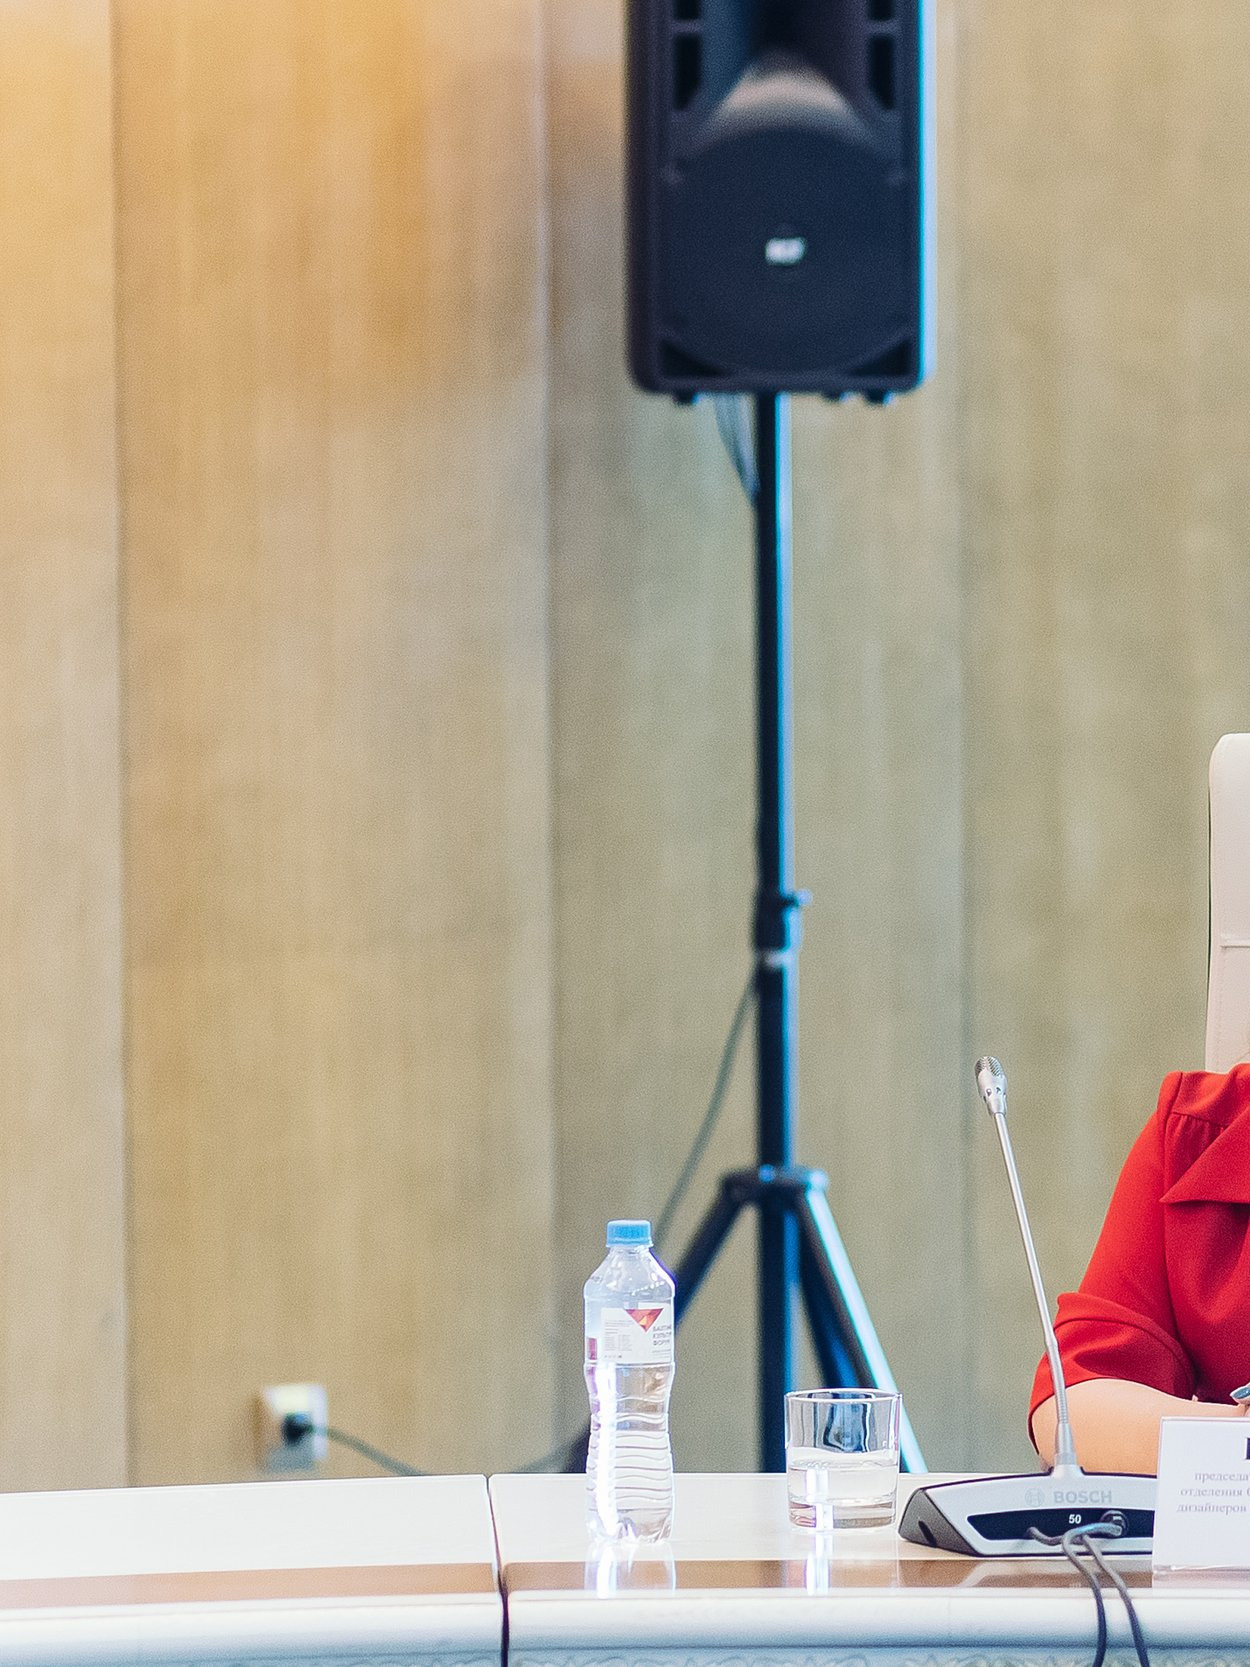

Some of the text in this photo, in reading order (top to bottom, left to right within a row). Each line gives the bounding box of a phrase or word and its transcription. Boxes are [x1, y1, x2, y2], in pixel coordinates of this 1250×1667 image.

[1053, 1490, 1112, 1504] BOSCH
[1180, 1487, 1243, 1498] отделения
[1177, 1502, 1247, 1515] дизайнеров
[1068, 1514, 1082, 1524] 50
